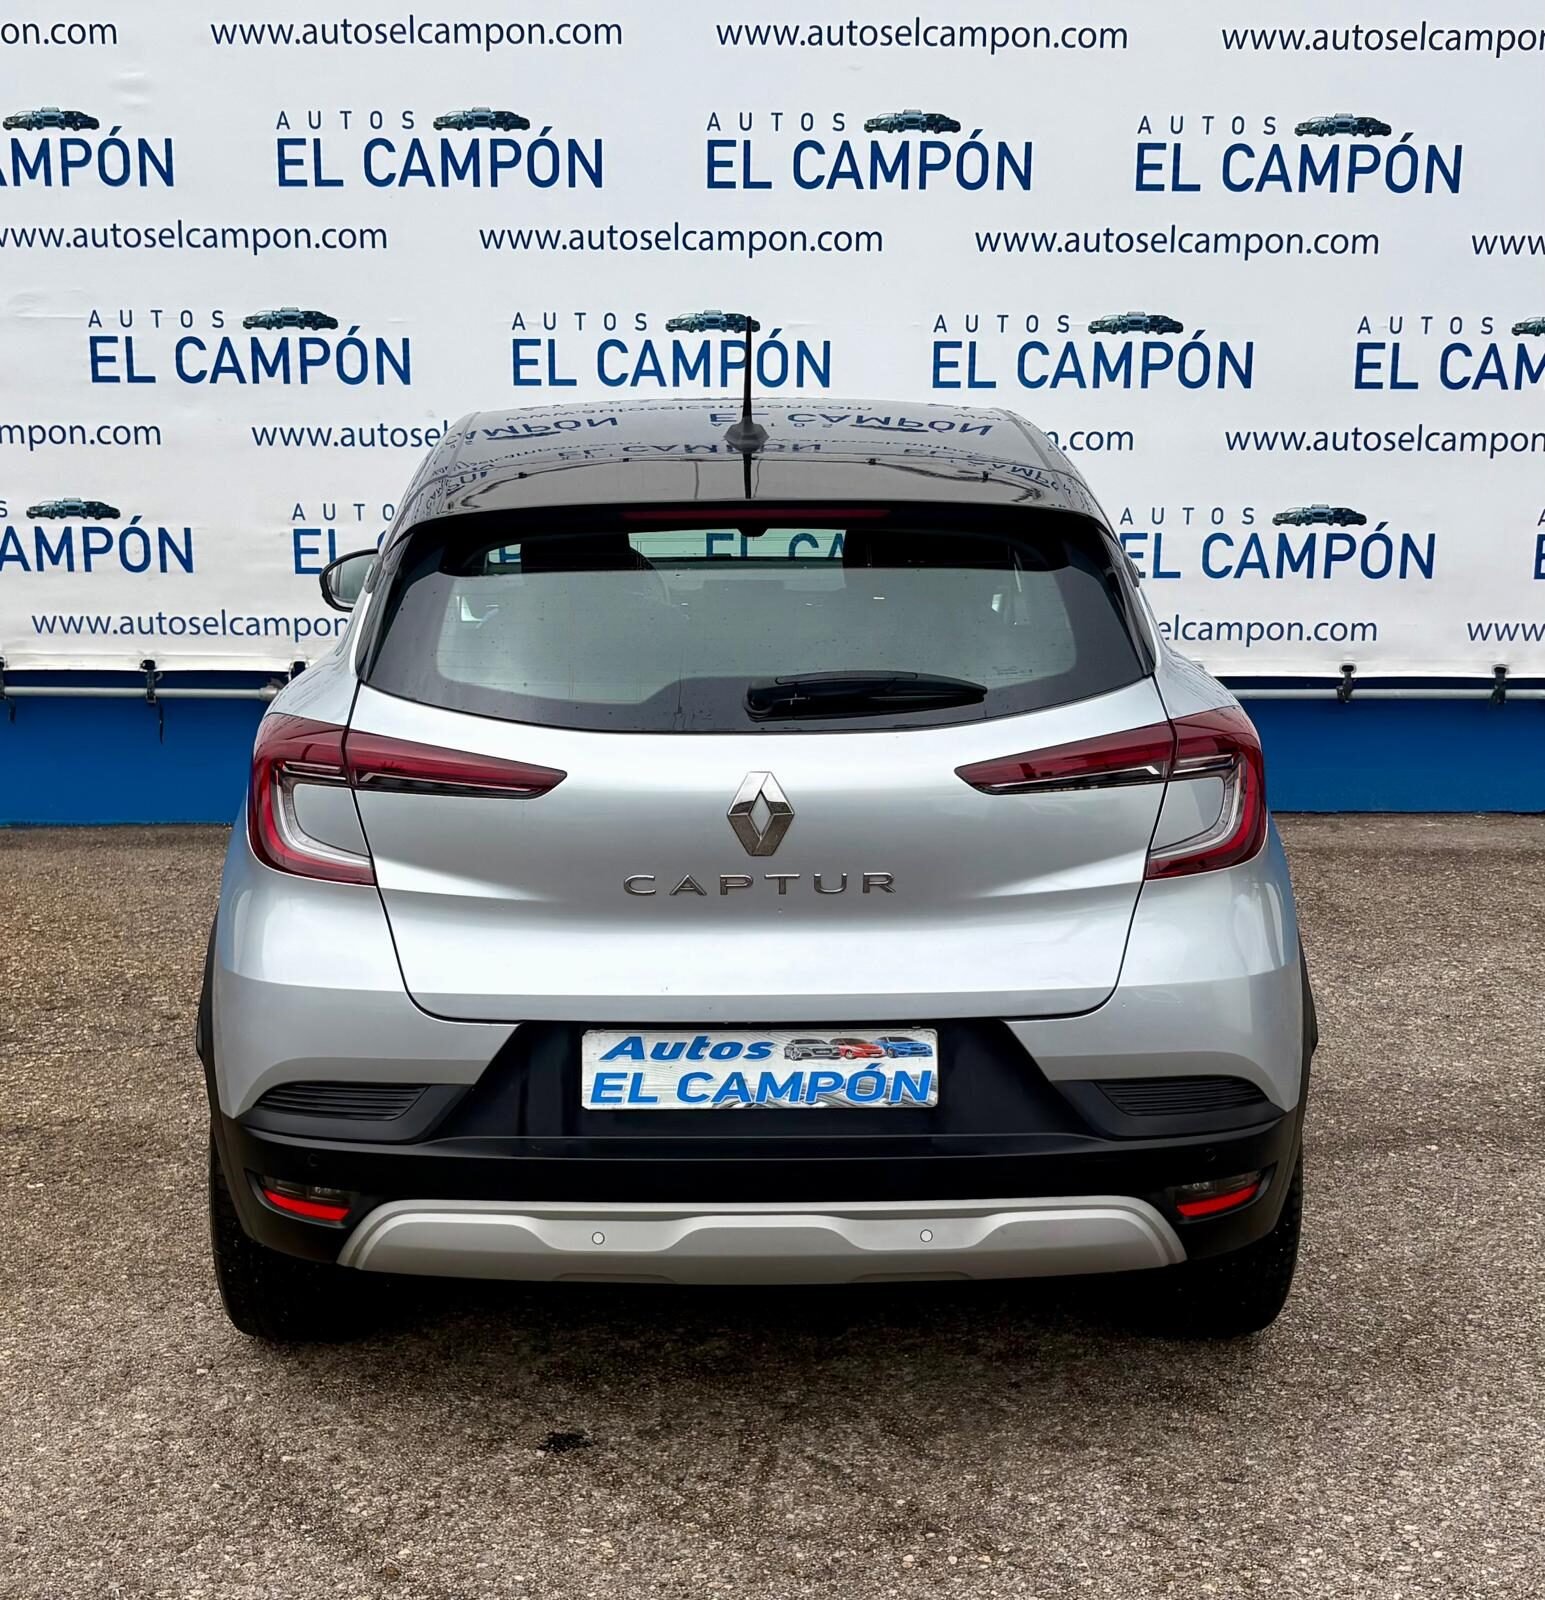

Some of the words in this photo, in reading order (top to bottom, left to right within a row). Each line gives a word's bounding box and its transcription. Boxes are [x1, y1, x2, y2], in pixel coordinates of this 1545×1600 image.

[1, 24, 116, 44] on.com
[211, 15, 621, 51] www.autoselcampon.com
[717, 17, 1127, 55] www.autoselcampon.com
[277, 111, 414, 129] AUTOS
[707, 112, 844, 131] AUTOS
[1138, 116, 1275, 135] AUTOS
[277, 138, 343, 186] EL
[364, 127, 602, 188] CAMPÓN
[707, 140, 772, 189] EL
[794, 131, 1032, 190] CAMPÓN
[1136, 143, 1200, 191] EL
[1223, 132, 1462, 193] CAMPÓN
[480, 222, 882, 258] www.autoselcampon.com
[976, 225, 1378, 261] www.autoselcampon.com
[89, 310, 224, 328] AUTOS
[512, 312, 646, 331] AUTOS
[934, 315, 1069, 333] AUTOS
[1358, 316, 1493, 334] AUTOS
[90, 336, 156, 383] EL
[176, 326, 410, 385] CAMPÓN
[513, 339, 577, 386] EL
[598, 328, 830, 386] CAMPÓN
[933, 341, 996, 388] EL
[1018, 330, 1253, 389] CAMPÓN
[1355, 343, 1418, 389] EL
[0, 425, 160, 451] mpon.com
[292, 503, 395, 521] AUTO
[1120, 508, 1254, 524] AUTOS
[1202, 522, 1435, 579] CAMPÓN
[623, 872, 896, 896] CAPTUR
[599, 1035, 777, 1062] Autos
[589, 1072, 659, 1104] EL
[676, 1063, 934, 1104] CAMPÓN
